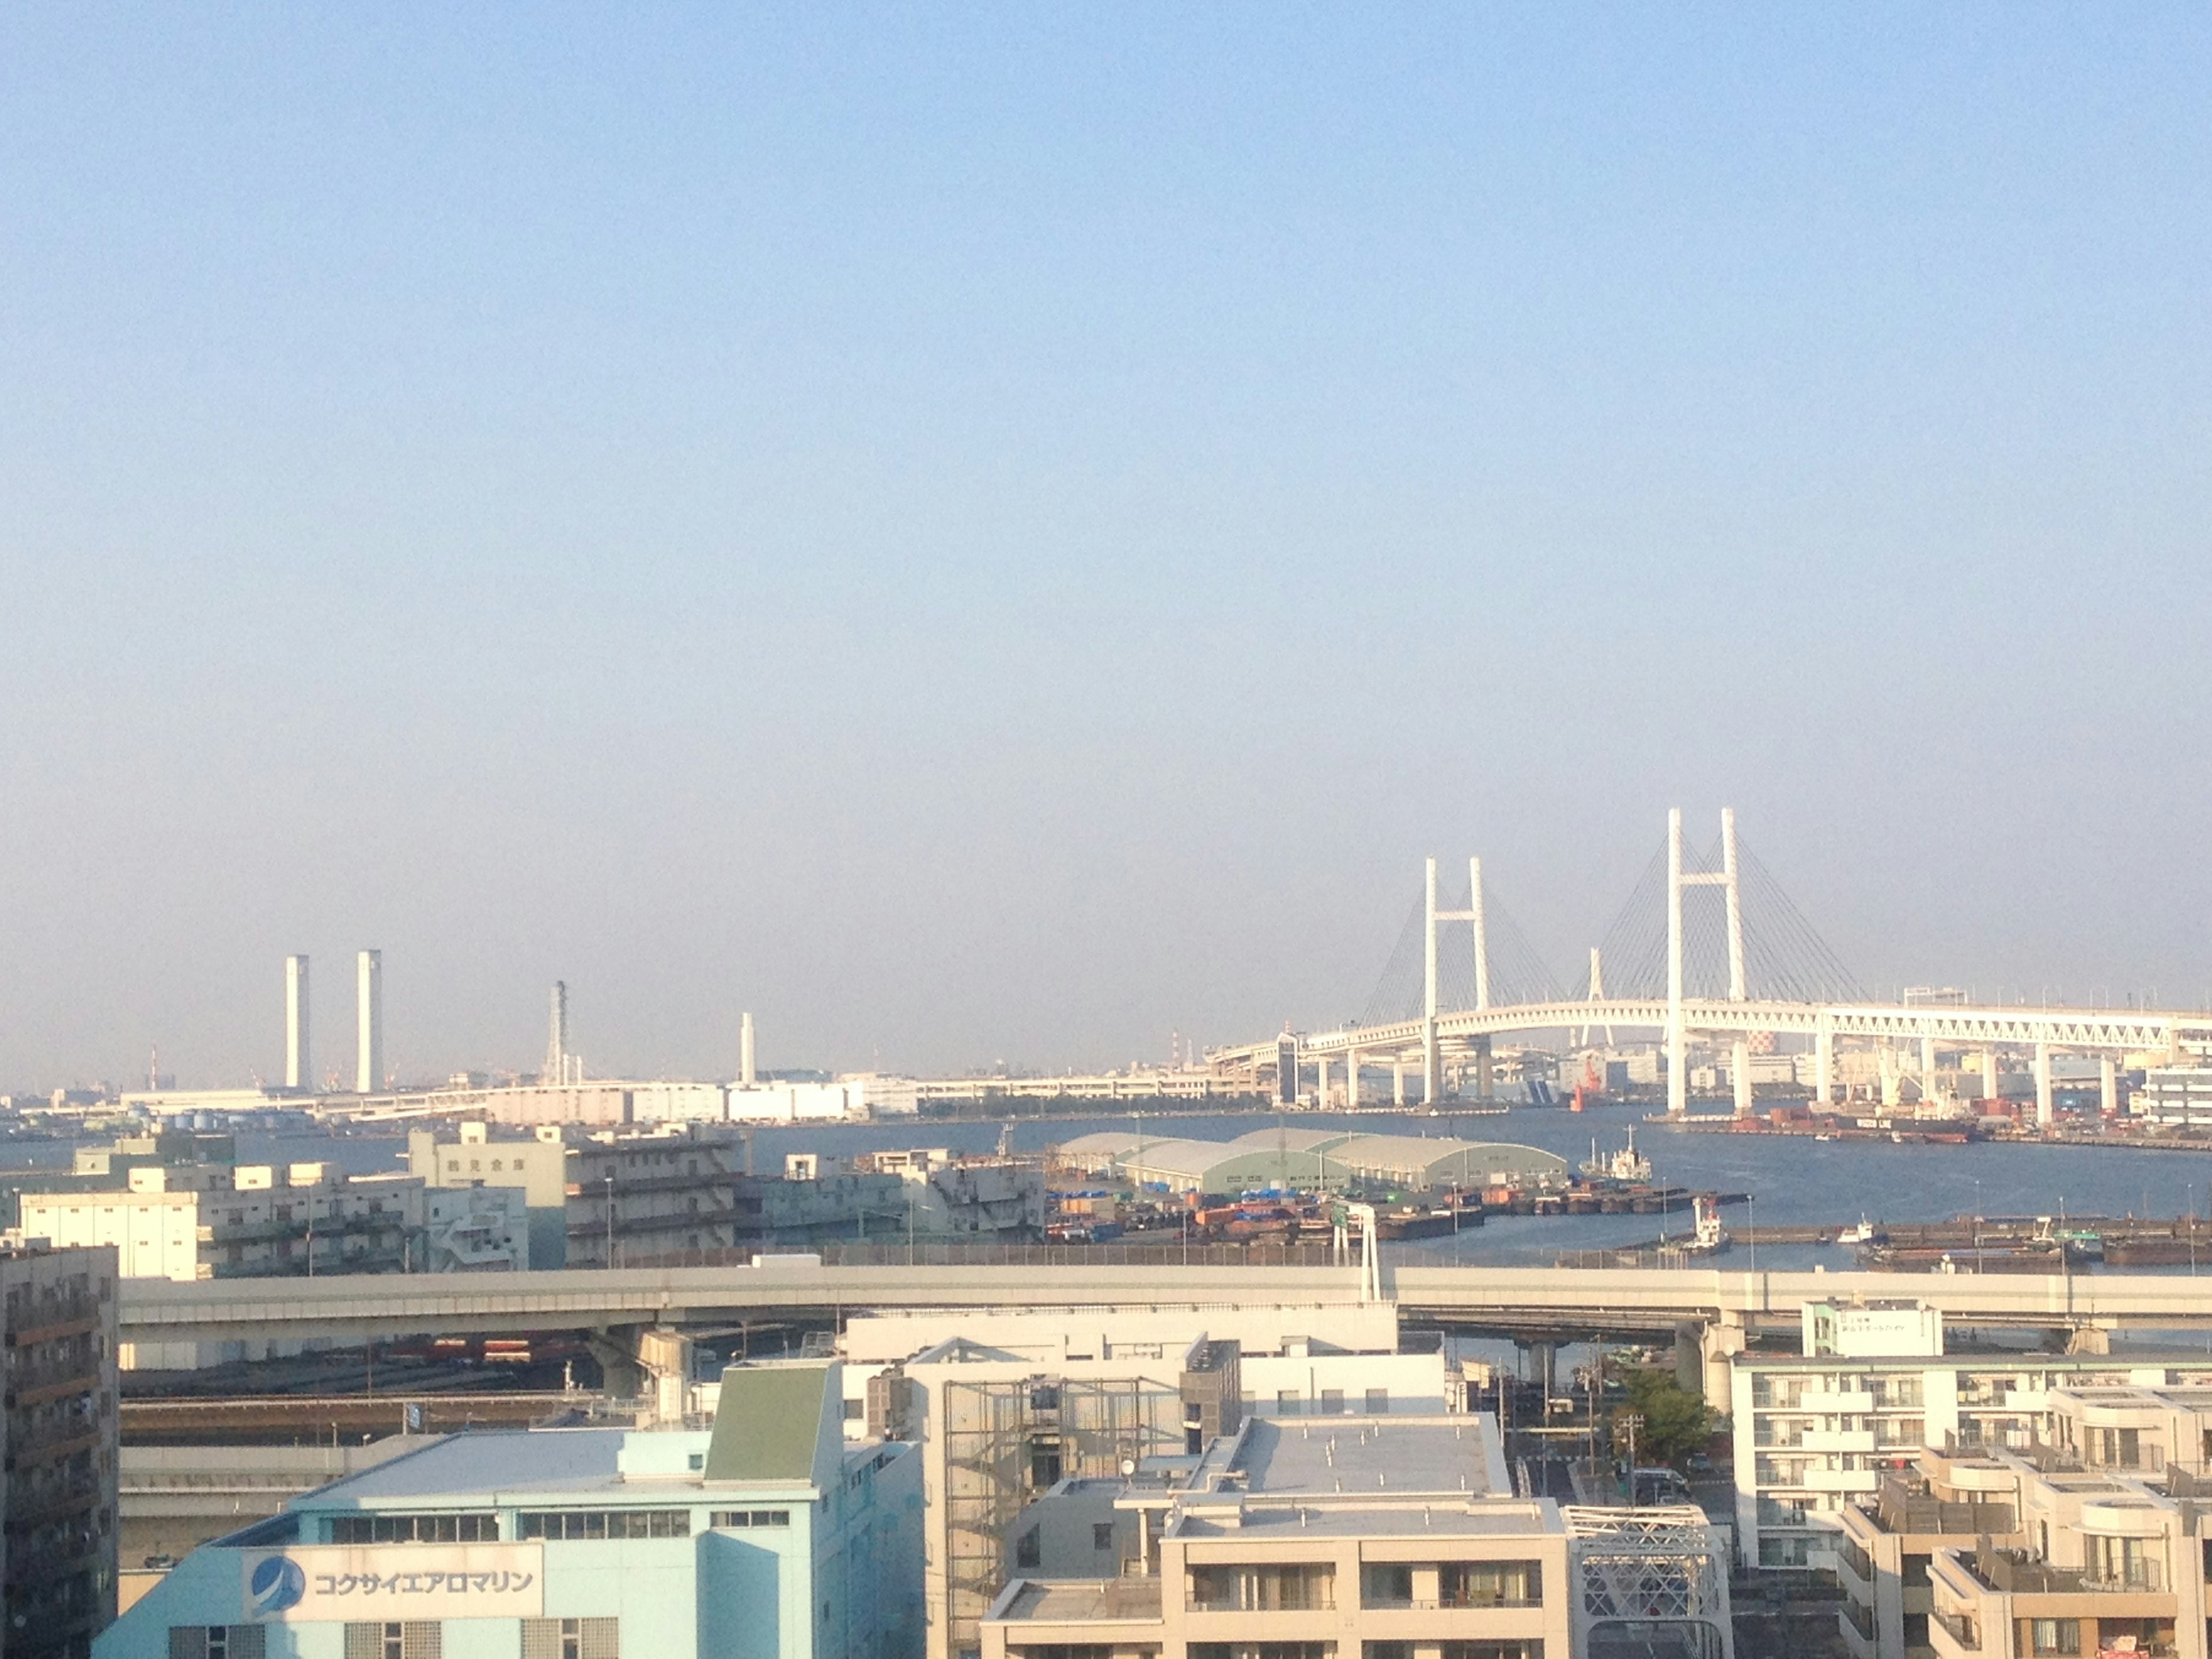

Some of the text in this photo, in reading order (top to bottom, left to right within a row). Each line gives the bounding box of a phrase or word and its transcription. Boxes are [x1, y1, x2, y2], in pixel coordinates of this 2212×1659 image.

[316, 1572, 533, 1595] コクサイエアロマリン
